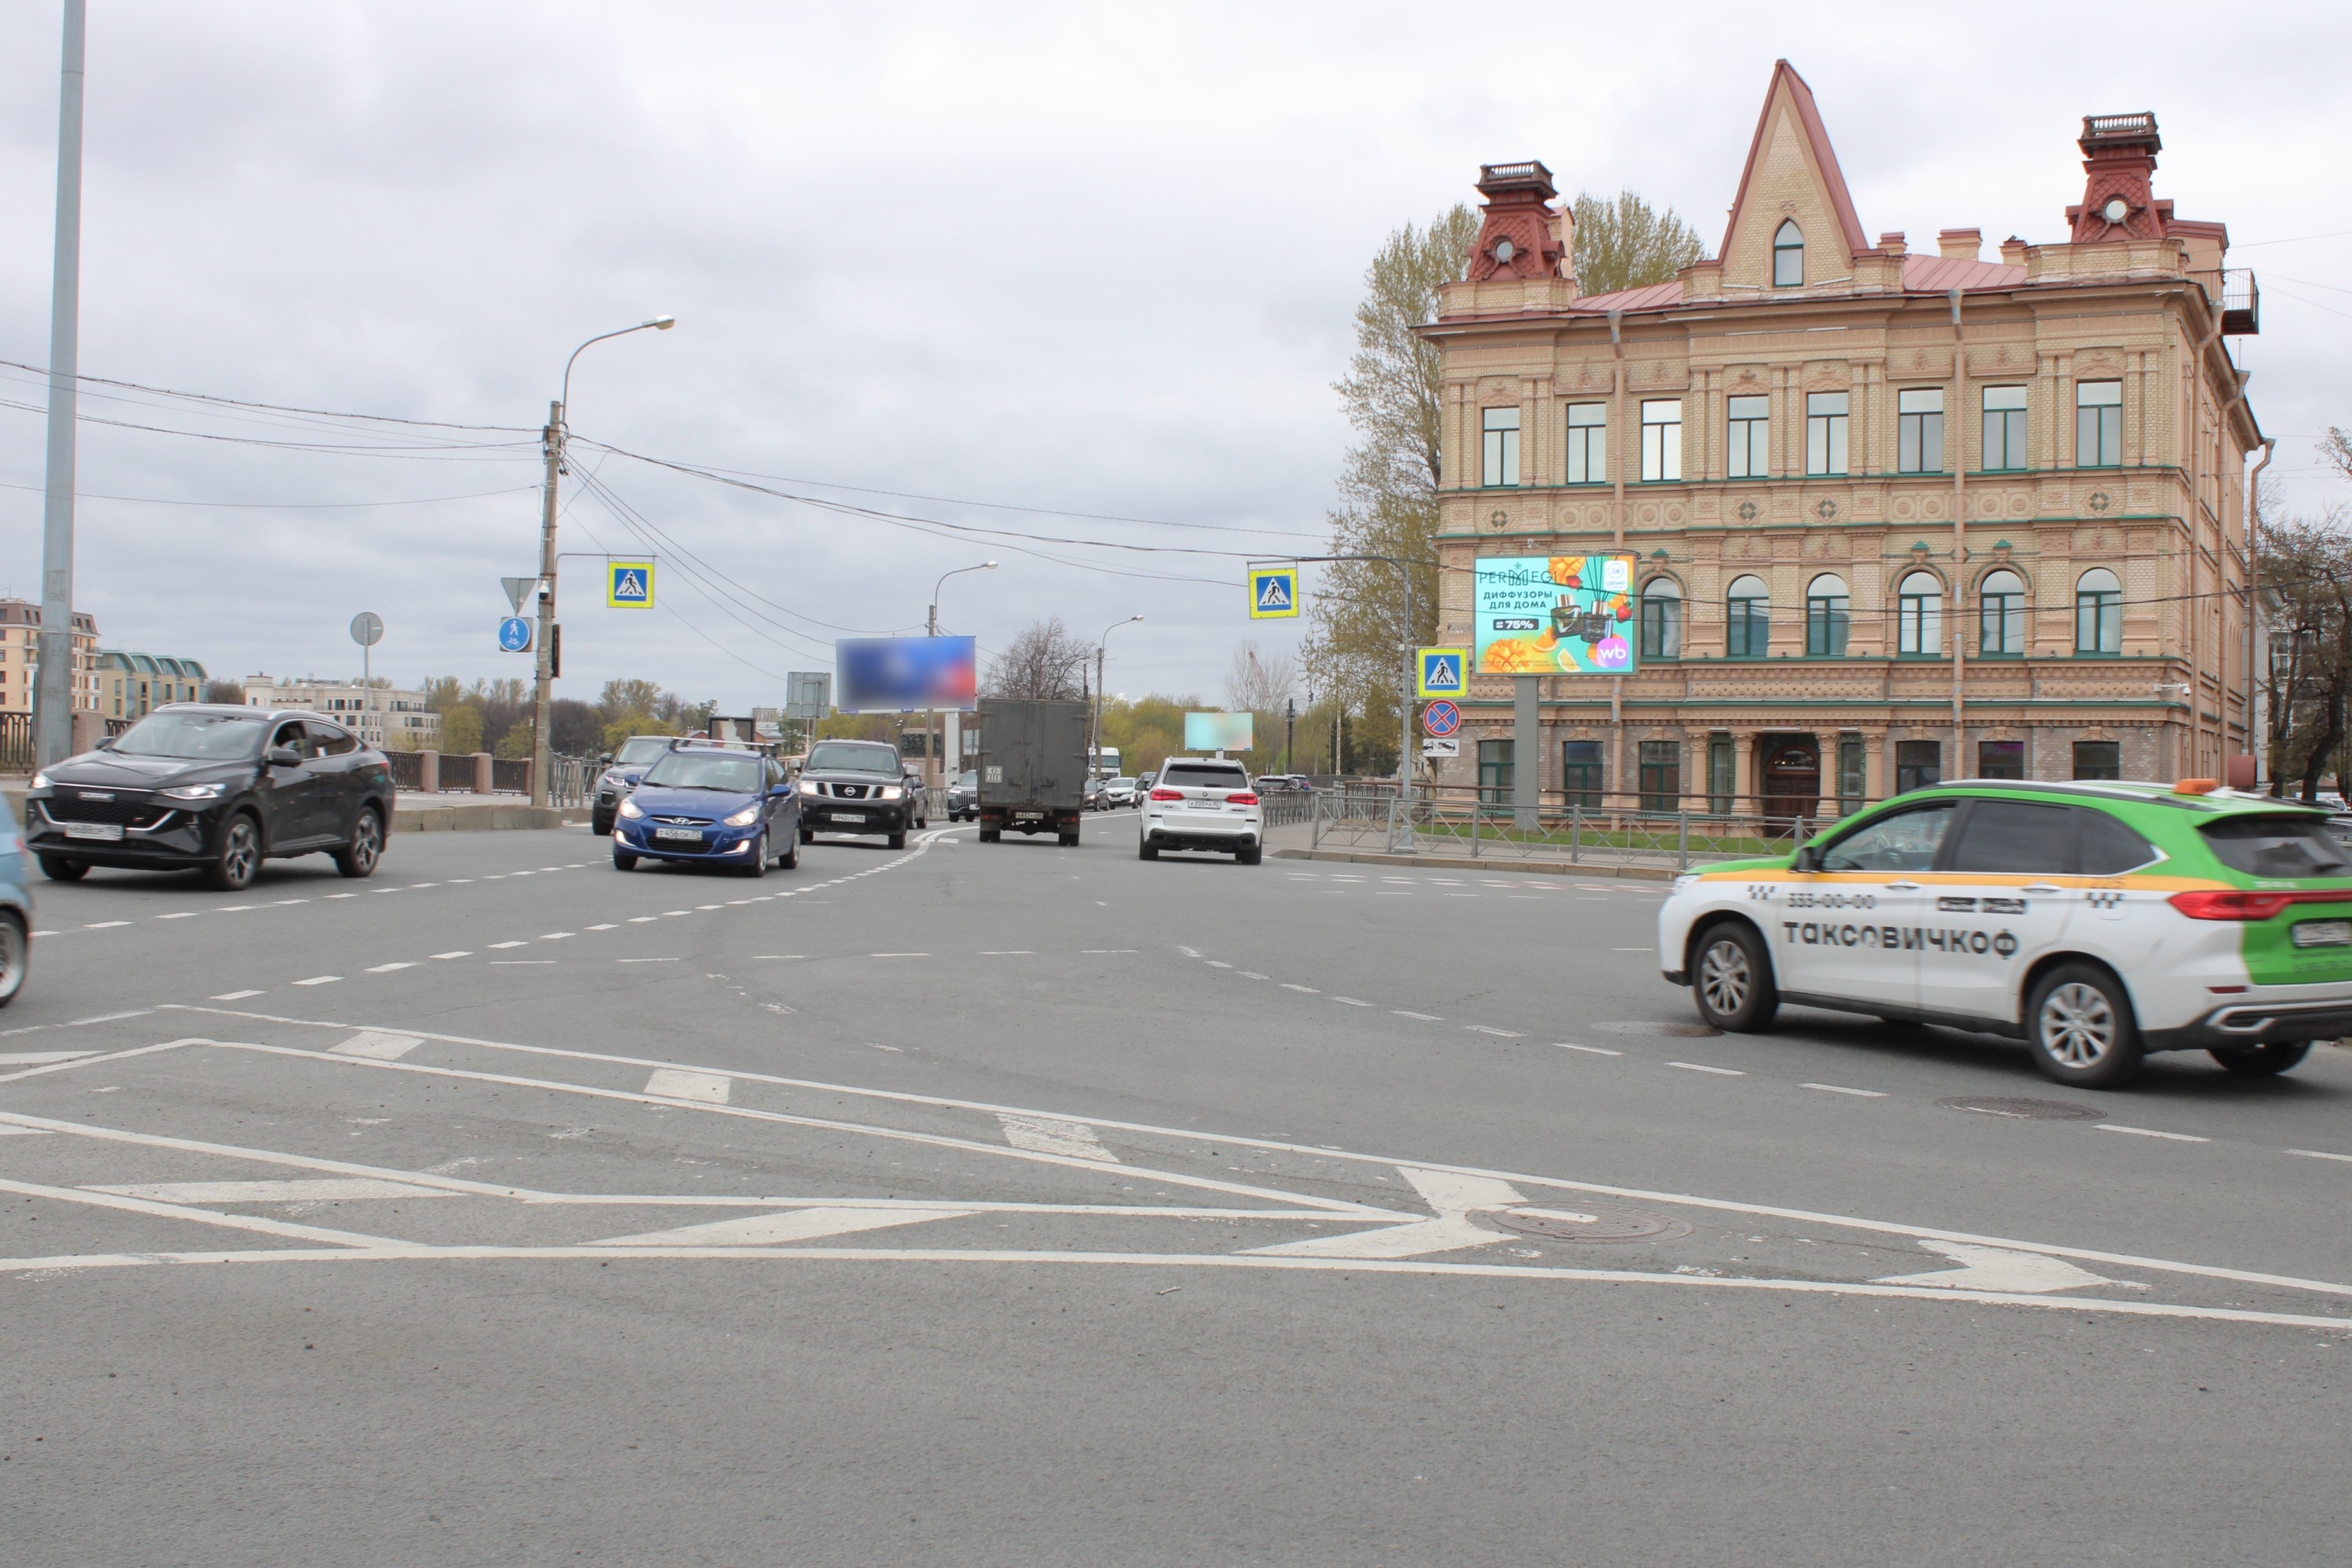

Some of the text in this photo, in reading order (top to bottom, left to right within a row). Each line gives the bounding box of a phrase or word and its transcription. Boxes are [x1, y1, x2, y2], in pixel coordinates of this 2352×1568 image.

[1483, 591, 1552, 600] ДИФФУЗОРЫ
[1489, 601, 1546, 610] ДЛЯ ДОМА
[1599, 644, 1626, 659] wb
